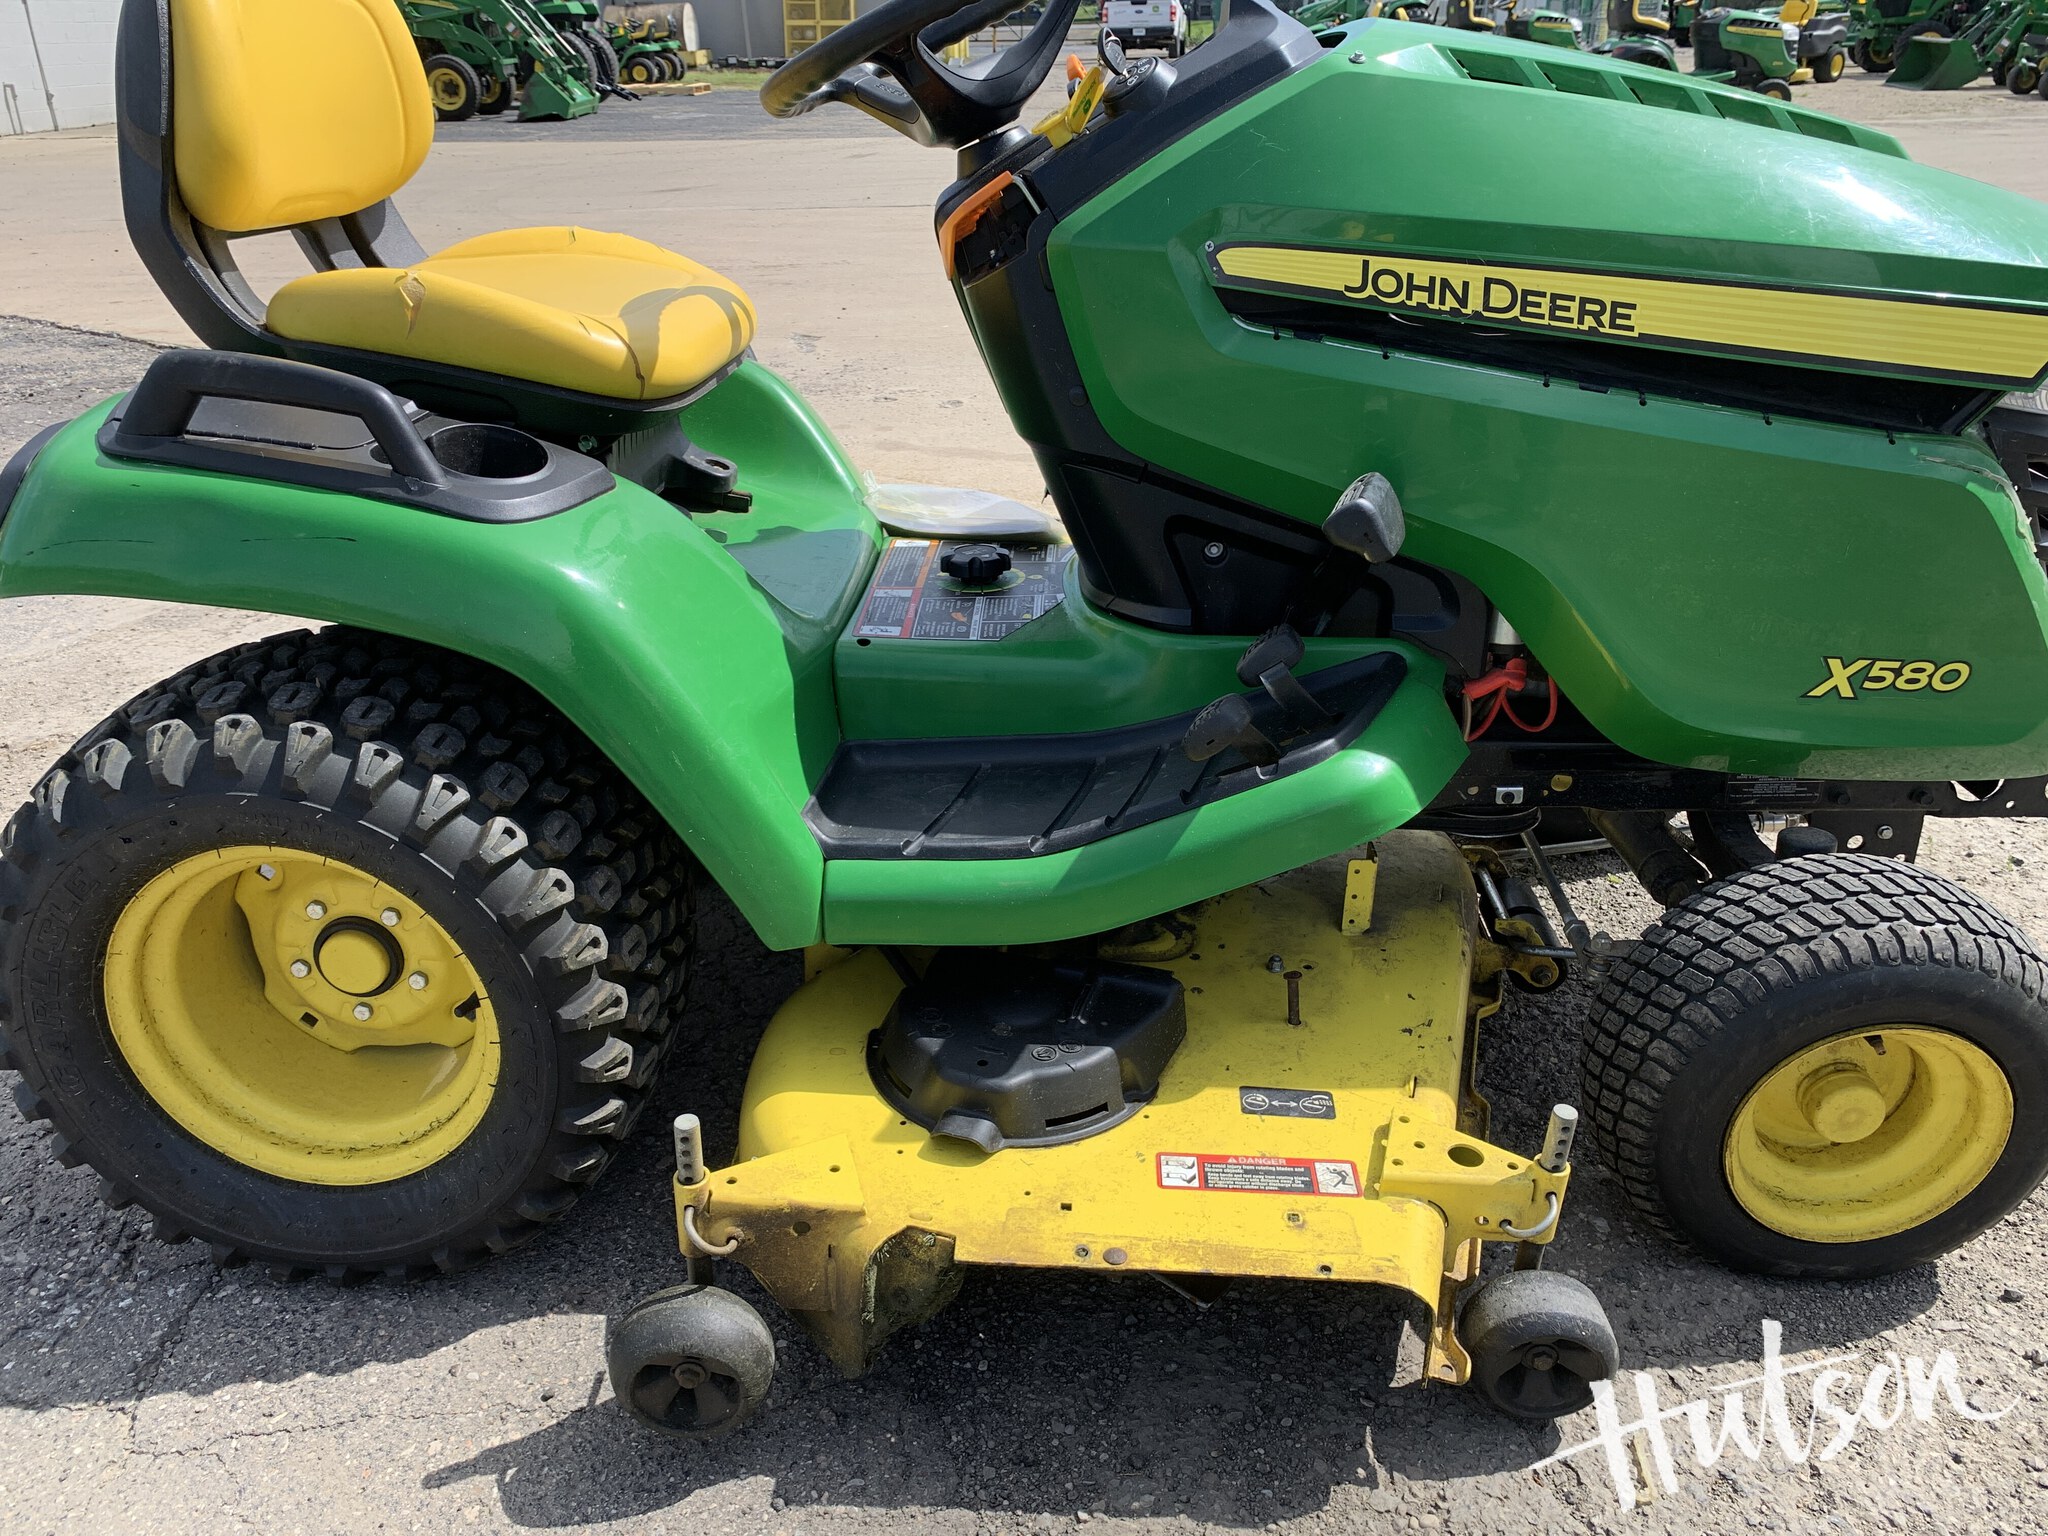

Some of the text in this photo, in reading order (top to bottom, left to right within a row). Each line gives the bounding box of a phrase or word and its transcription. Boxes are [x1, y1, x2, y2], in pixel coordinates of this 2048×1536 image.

[1344, 259, 1638, 333] JOHN DEERE
[1801, 656, 1972, 700] X580
[1238, 1156, 1286, 1165] DANGER
